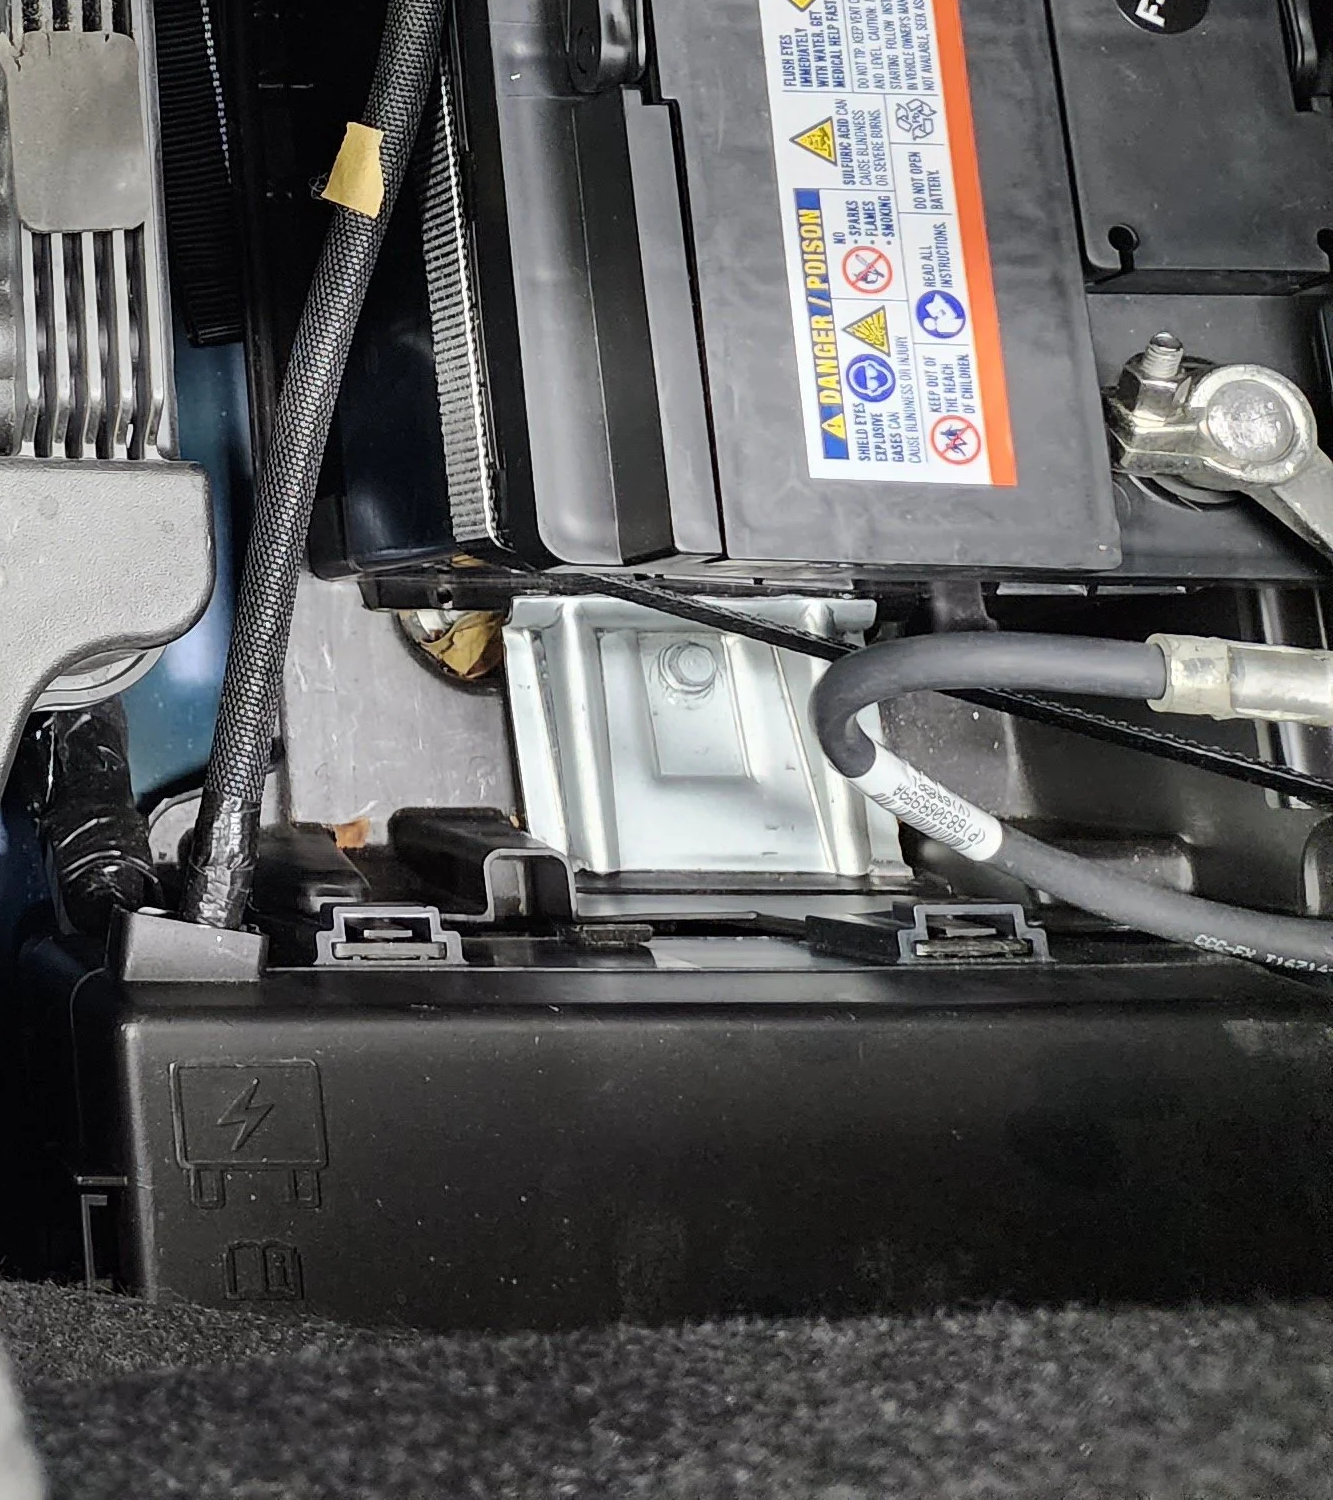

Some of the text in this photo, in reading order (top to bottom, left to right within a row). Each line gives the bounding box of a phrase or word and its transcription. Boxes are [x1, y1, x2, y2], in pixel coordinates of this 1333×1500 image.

[849, 6, 862, 23] VENT
[914, 12, 927, 30] SEEK
[808, 10, 829, 87] WITH WATER. GET
[826, 24, 841, 46] HELP
[851, 25, 864, 43] KEEP
[882, 19, 897, 49] FOLLOW
[779, 34, 796, 86] FLUSH EYES
[794, 27, 813, 86] IMMEDIATELY
[829, 49, 845, 87] MEDICAL
[855, 61, 867, 75] NOT
[886, 54, 902, 89] STARTING
[902, 51, 917, 80] VEHICLE
[857, 78, 869, 88] DO
[872, 73, 885, 89] AND
[905, 82, 918, 90] IN
[921, 76, 934, 90] NOT
[834, 99, 855, 185] SULFURIC ACID CAN
[852, 109, 872, 185] CAUSE BLINDNESS
[871, 141, 886, 171] SEVERE
[875, 174, 888, 186] OR
[908, 151, 926, 209] DO NOT OPEN
[845, 200, 861, 235] SPARKS
[862, 200, 877, 236] FLAMES
[877, 195, 894, 236] SMOKING
[797, 209, 828, 288] POISON
[832, 232, 845, 244] NO
[919, 244, 936, 286] READ ALL
[809, 314, 841, 404] DANGER
[898, 368, 912, 380] OR
[923, 355, 941, 412] KEEP OUT OF
[940, 363, 958, 413] THE REACH
[900, 383, 918, 432] BLINDNESS
[961, 403, 975, 413] OF
[852, 402, 870, 461] SHIELD EYES
[870, 412, 887, 461] EXPLOSIVE
[887, 412, 904, 462] GASES CAN
[905, 435, 921, 463] CAUSE
